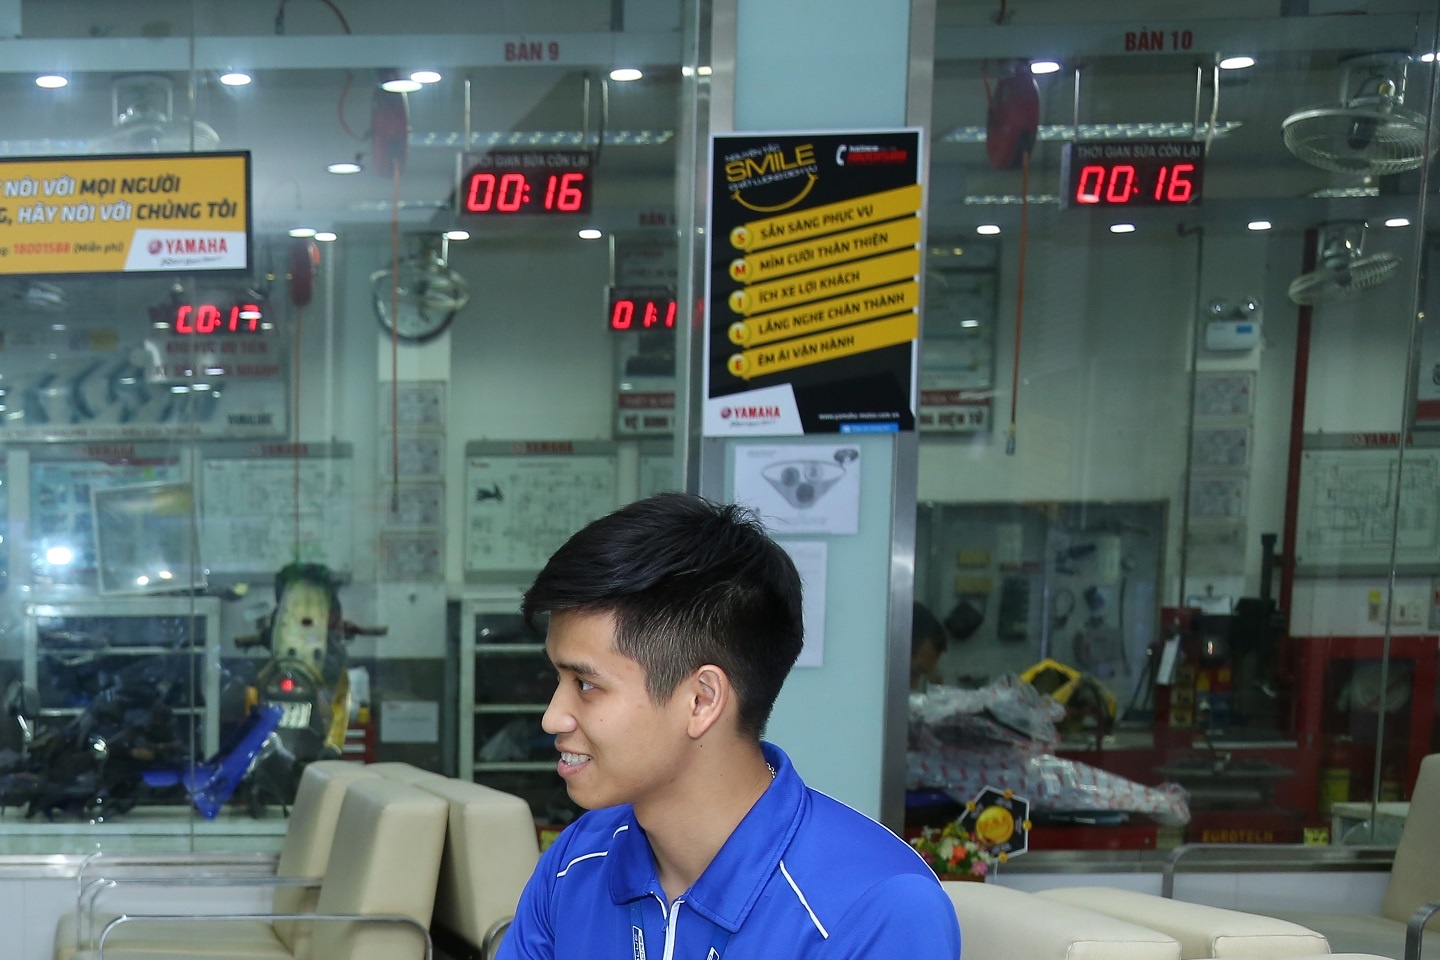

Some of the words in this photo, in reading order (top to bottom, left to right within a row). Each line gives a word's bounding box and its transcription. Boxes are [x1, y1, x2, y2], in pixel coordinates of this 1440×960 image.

[1172, 30, 1193, 50] 10
[549, 42, 559, 61] 9
[725, 143, 816, 183] SMILE
[4, 176, 38, 197] NÓI
[42, 173, 75, 197] VỚI
[80, 178, 115, 197] MỌI
[121, 174, 180, 194] NGƯỜI
[1077, 164, 1194, 203] 00:16
[467, 173, 584, 212] 00:16
[17, 201, 59, 223] HÃY
[61, 201, 95, 222] NÓI
[100, 199, 133, 221] VỚI
[137, 201, 201, 220] CHÚNG
[208, 198, 238, 218] TÔI
[166, 238, 228, 255] YAMAHA
[736, 233, 746, 245] S
[735, 264, 746, 275] M
[782, 285, 796, 297] XE
[793, 312, 824, 328] NGHE
[735, 329, 743, 340] L
[735, 360, 743, 370] E
[734, 406, 781, 419] YAMAHA
